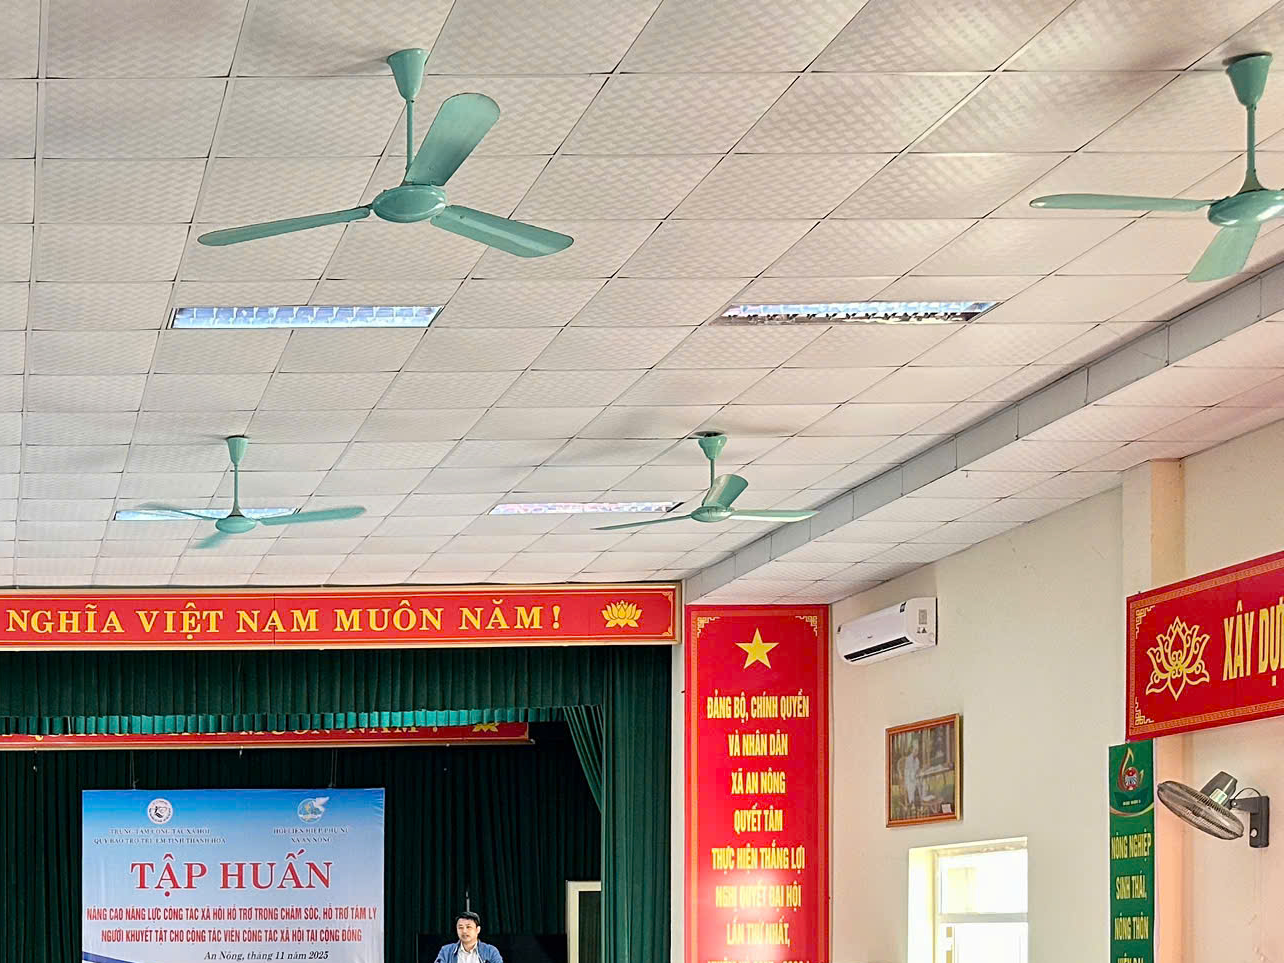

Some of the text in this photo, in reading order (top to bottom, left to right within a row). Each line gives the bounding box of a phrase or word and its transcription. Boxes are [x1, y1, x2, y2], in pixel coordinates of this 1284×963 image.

[6, 603, 125, 633] NGHĨA
[136, 602, 224, 640] VIỆT
[236, 609, 319, 633] NAM
[333, 600, 444, 632] MUÔN
[458, 599, 544, 631] NĂM
[552, 605, 560, 629] !
[1223, 600, 1255, 681] XÂY
[707, 689, 778, 724] ĐẢNG BỘ, CHÍNH
[728, 729, 788, 756] VÀ NHÂN DÂN
[731, 767, 786, 794] XÃ AN NÔNG
[734, 802, 783, 834] QUYẾT TÂM
[712, 839, 805, 875] THỰC HIỆN THẮNG LỢI
[130, 849, 333, 897] TẬP HUẤN
[786, 880, 802, 911] HỘI
[109, 908, 123, 920] CAO
[255, 907, 278, 920] TRONG
[125, 926, 153, 942] KHUYẾT
[170, 930, 184, 942] CHO
[204, 951, 217, 960] An
[247, 951, 273, 961] tháng
[275, 951, 285, 960] 11
[287, 951, 307, 960] năm
[309, 950, 329, 960] 2025
